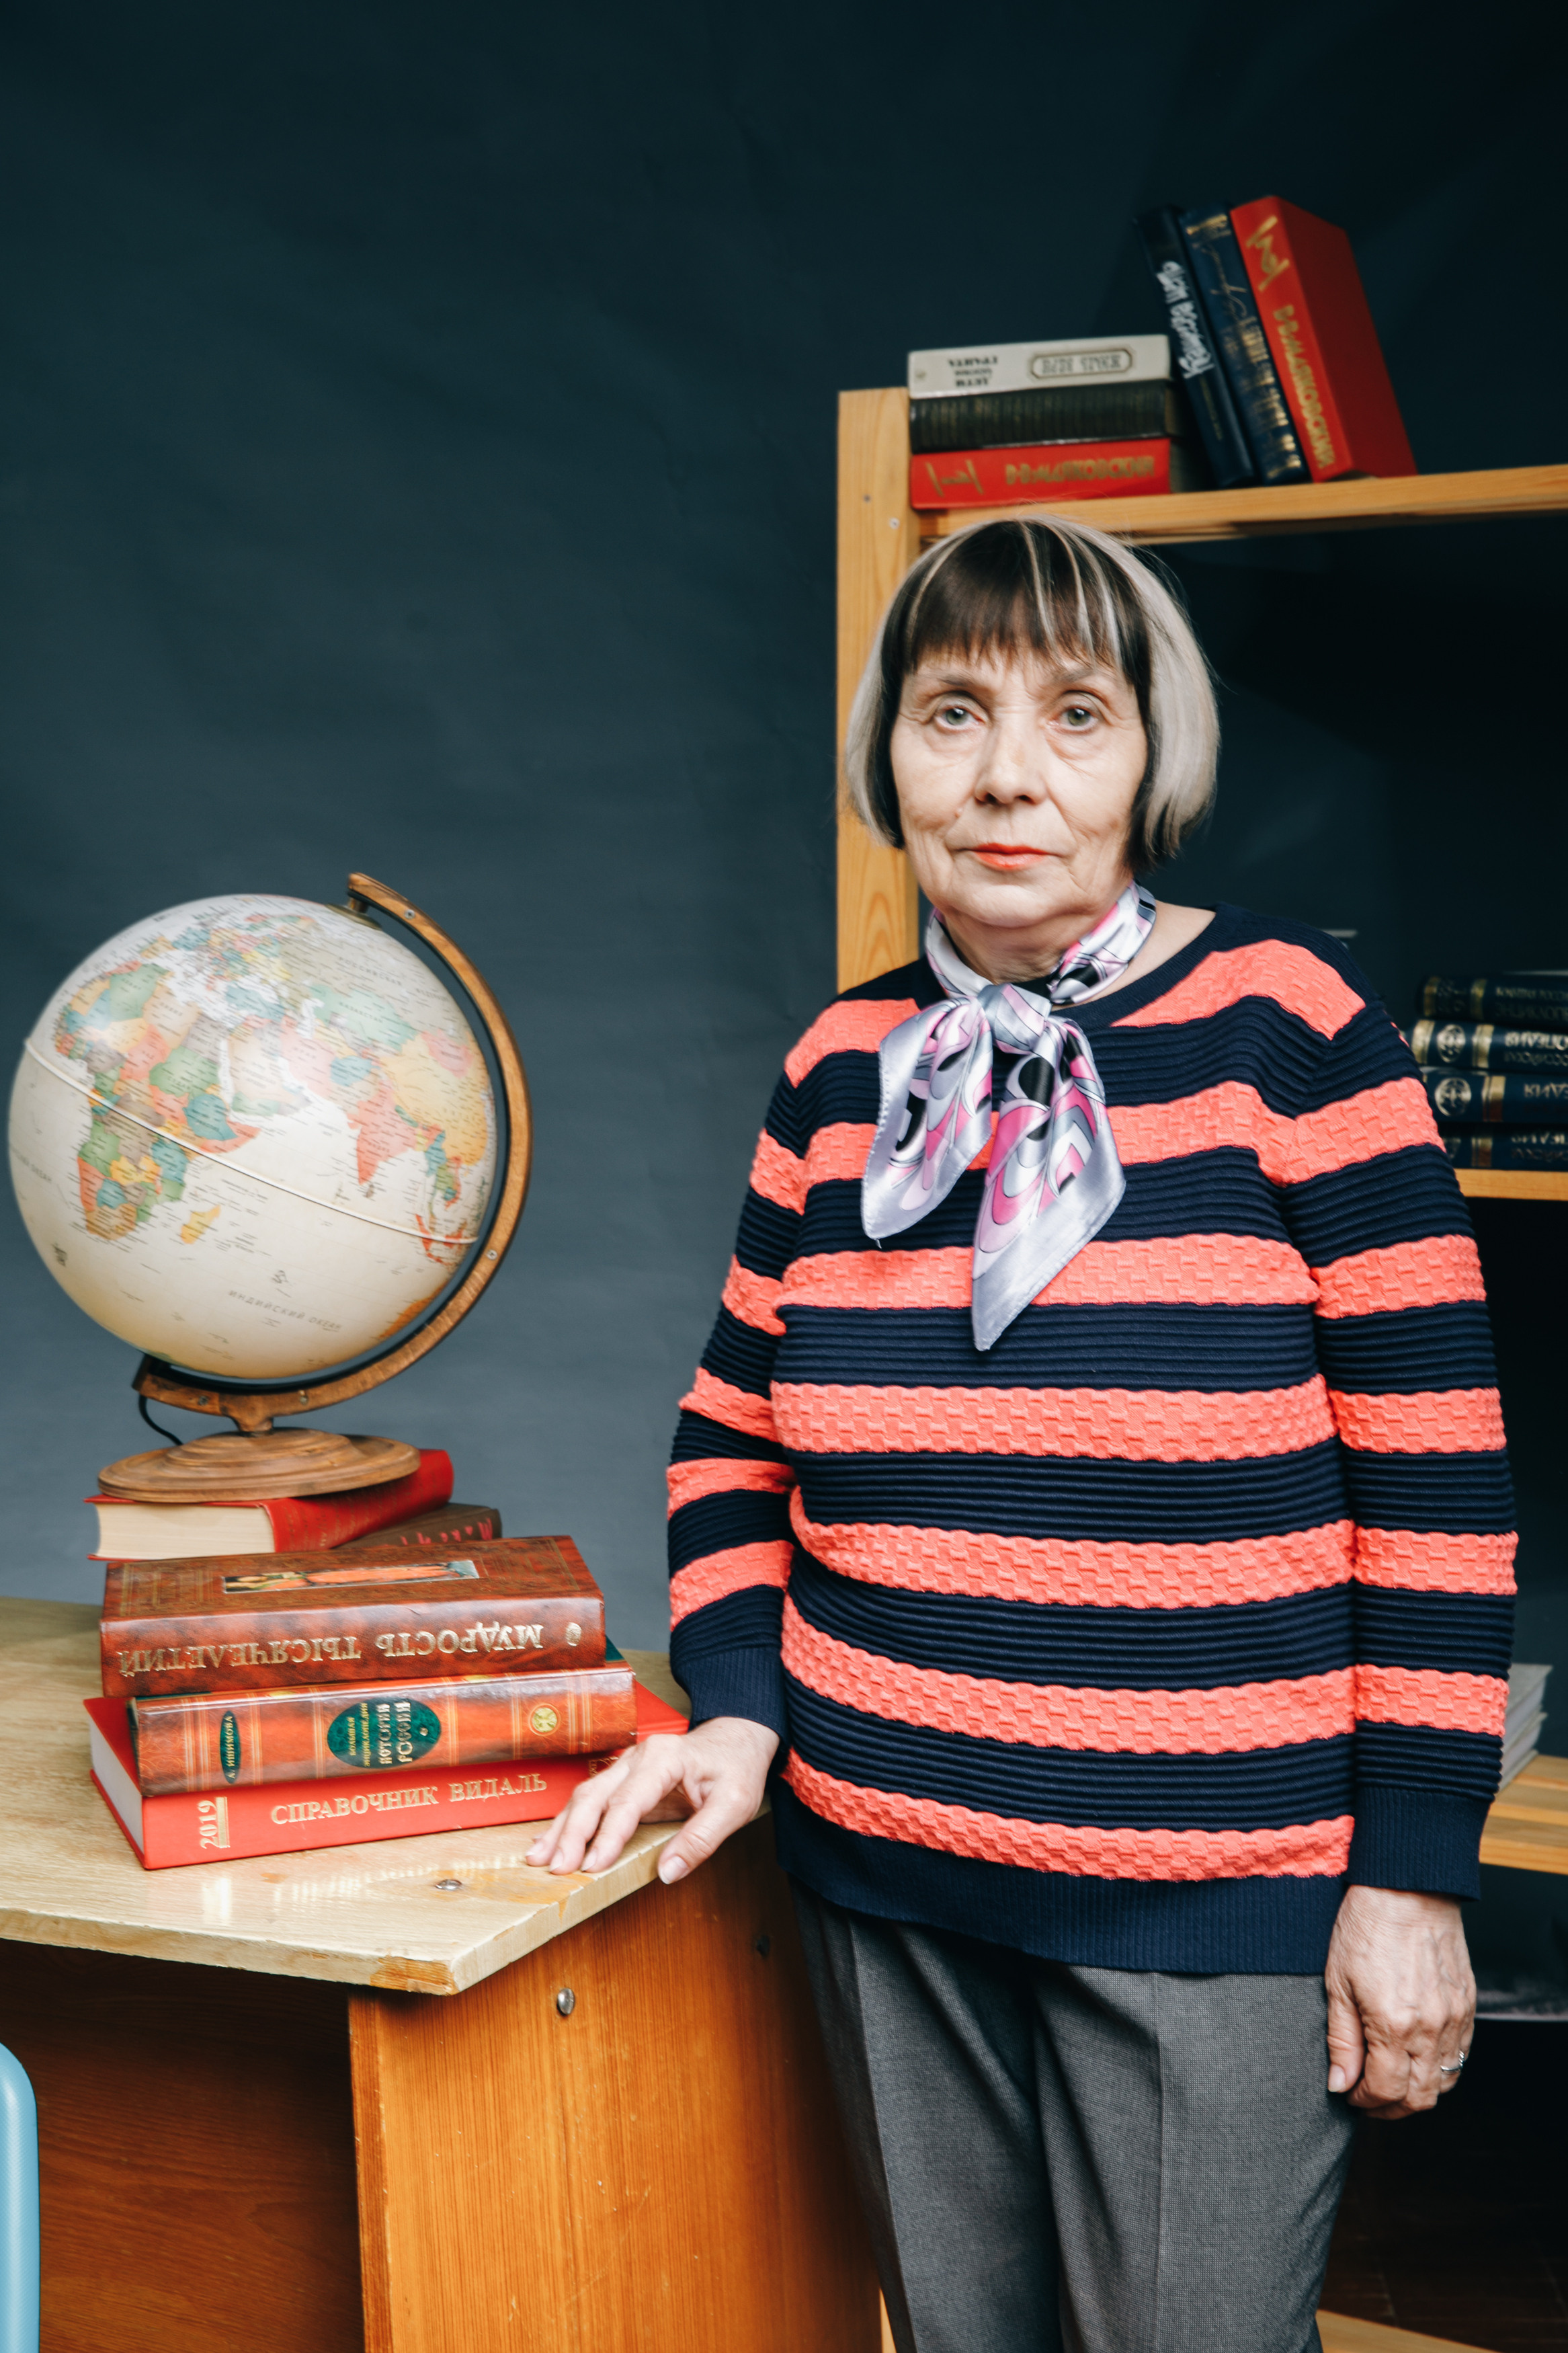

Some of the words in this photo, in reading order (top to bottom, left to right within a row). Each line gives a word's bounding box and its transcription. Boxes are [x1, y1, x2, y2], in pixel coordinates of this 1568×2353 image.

[118, 1634, 362, 1678] ТЫСЯЧЕЛЕТИЙ
[382, 1622, 544, 1659] МУДРОСТЬ
[224, 1715, 235, 1767] ИШИМОВА
[360, 1702, 371, 1767] ЭНЦИКЛОПЕДИЯ
[376, 1703, 393, 1765] ИСТОРИИ
[393, 1701, 413, 1763] РОССИИ
[271, 1786, 439, 1824] СПРАВОЧНИК
[448, 1773, 548, 1803] ВИДАЛЬ
[198, 1800, 225, 1849] 2019
